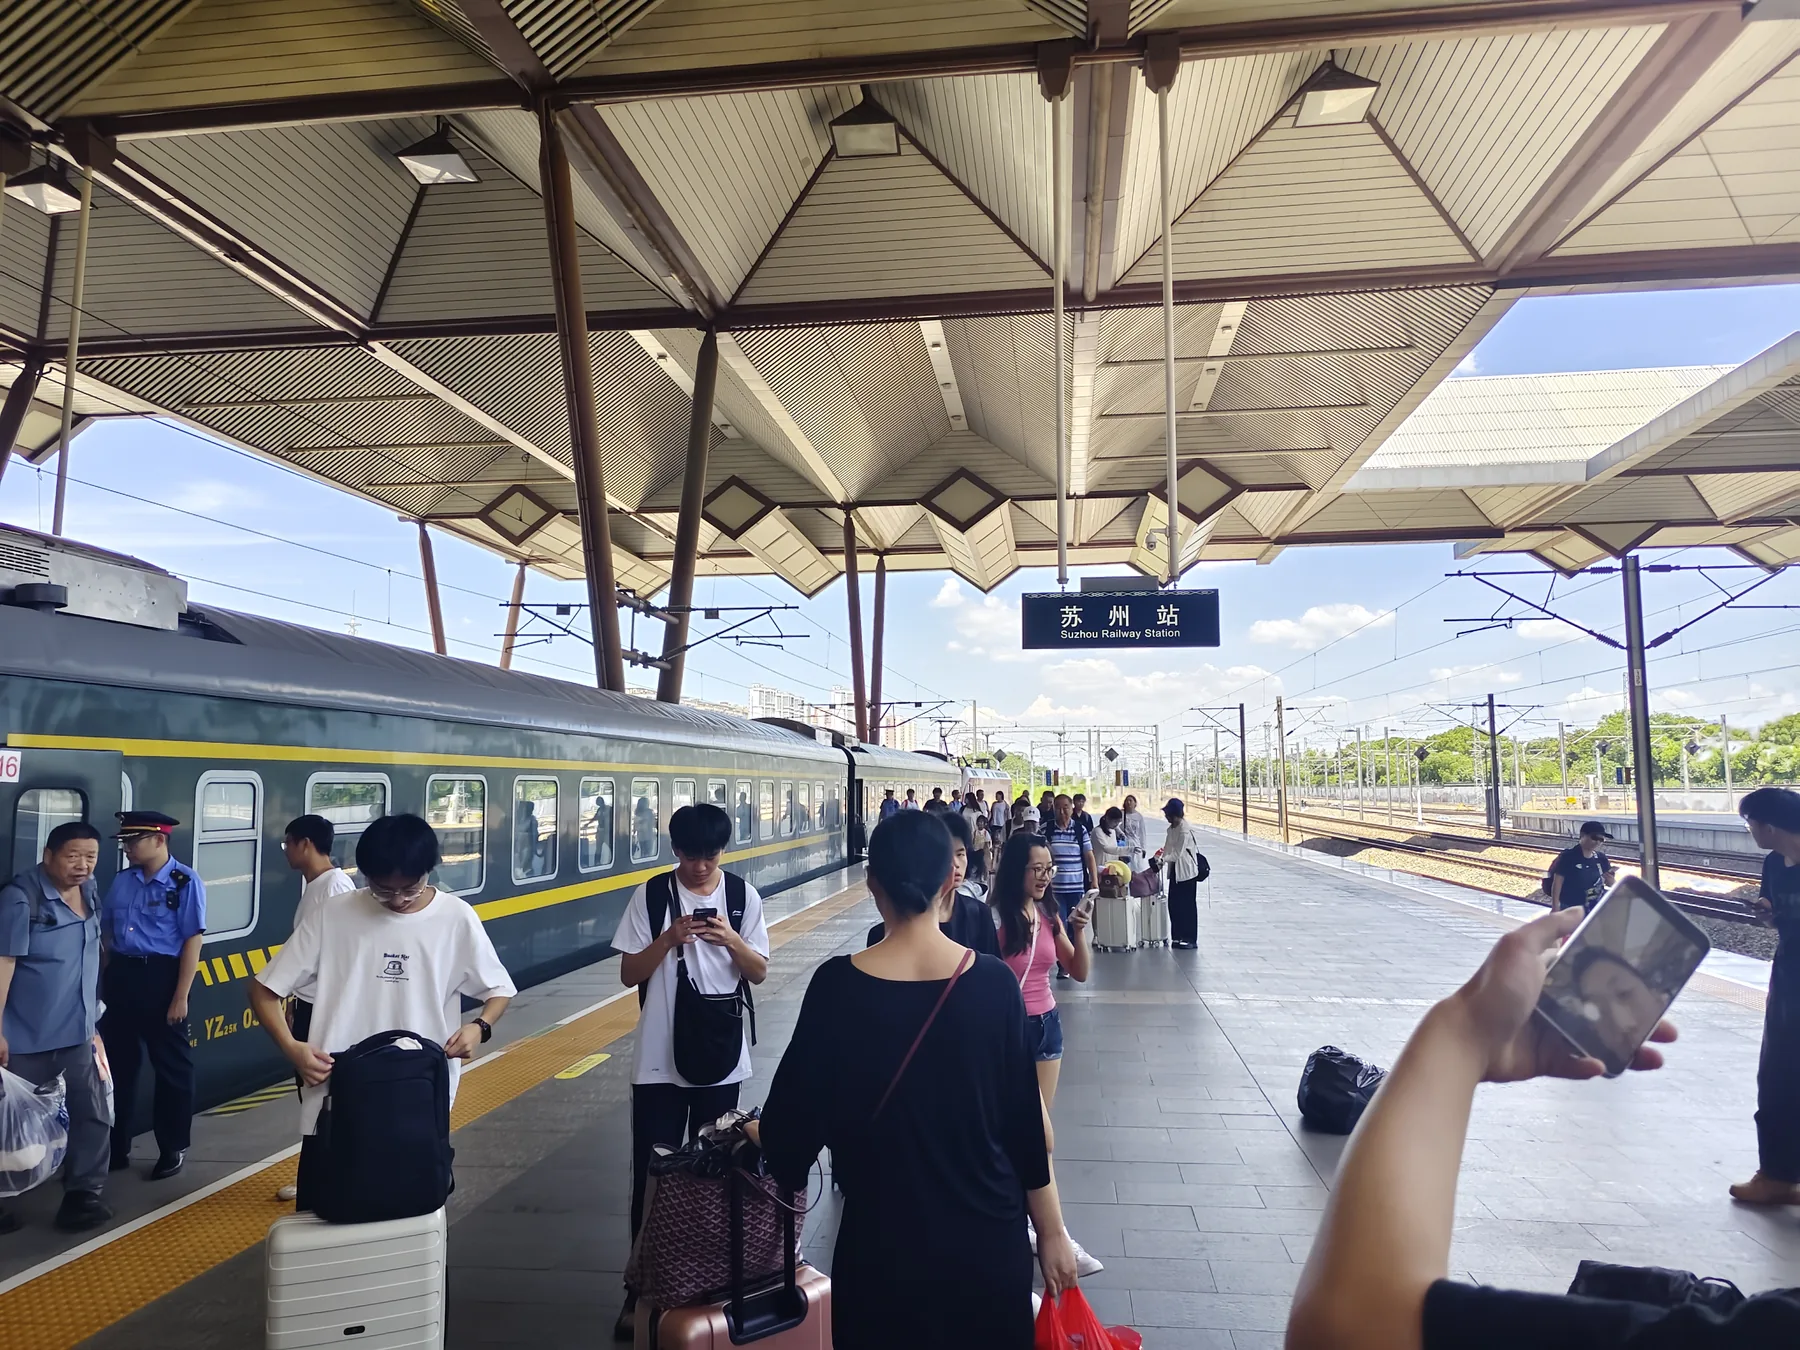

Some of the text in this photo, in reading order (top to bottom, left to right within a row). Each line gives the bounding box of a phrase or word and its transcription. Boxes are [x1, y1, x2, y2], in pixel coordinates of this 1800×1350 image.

[1060, 603, 1180, 628] 苏州站
[1060, 628, 1180, 640] Suzhou Railway Station
